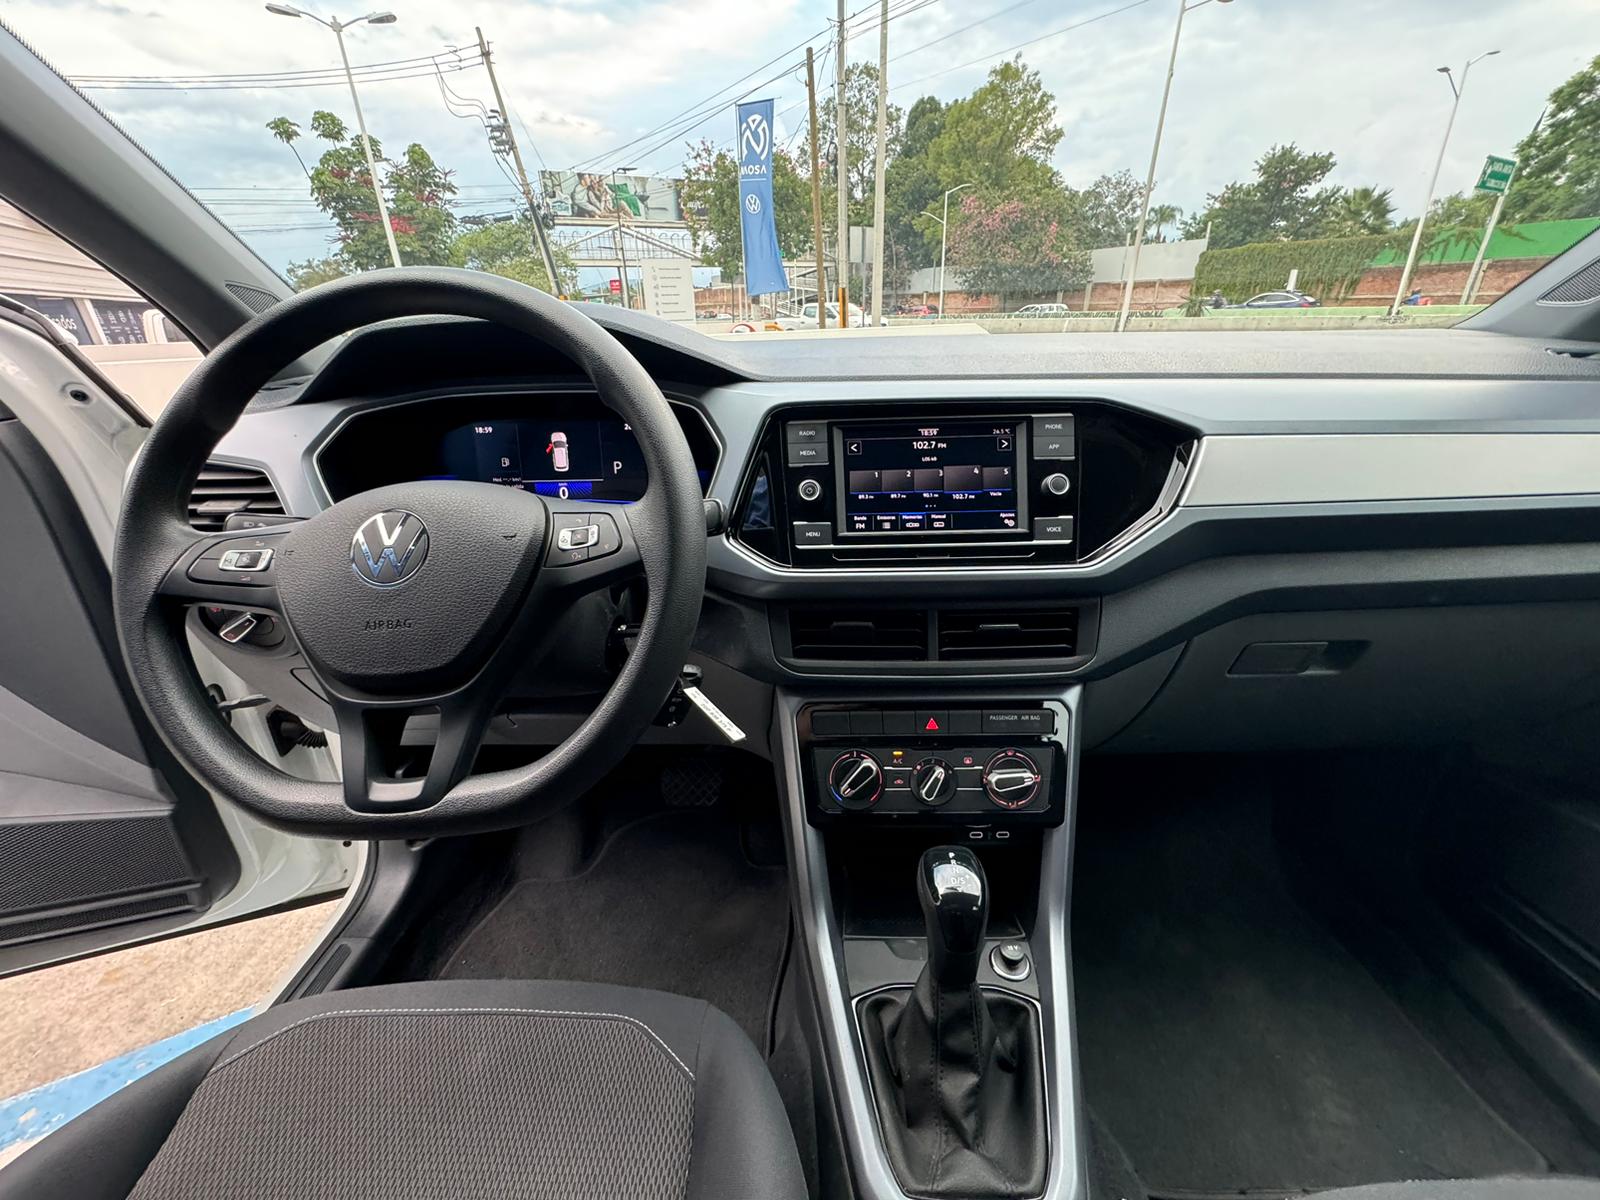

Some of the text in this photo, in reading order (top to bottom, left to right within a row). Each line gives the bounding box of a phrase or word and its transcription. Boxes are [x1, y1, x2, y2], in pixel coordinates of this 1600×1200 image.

[741, 165, 766, 175] MOSA
[475, 426, 492, 434] 18:59
[912, 441, 936, 449] 102.7
[613, 461, 623, 474] P
[559, 486, 569, 500] 0
[364, 619, 414, 630] AIRBAG
